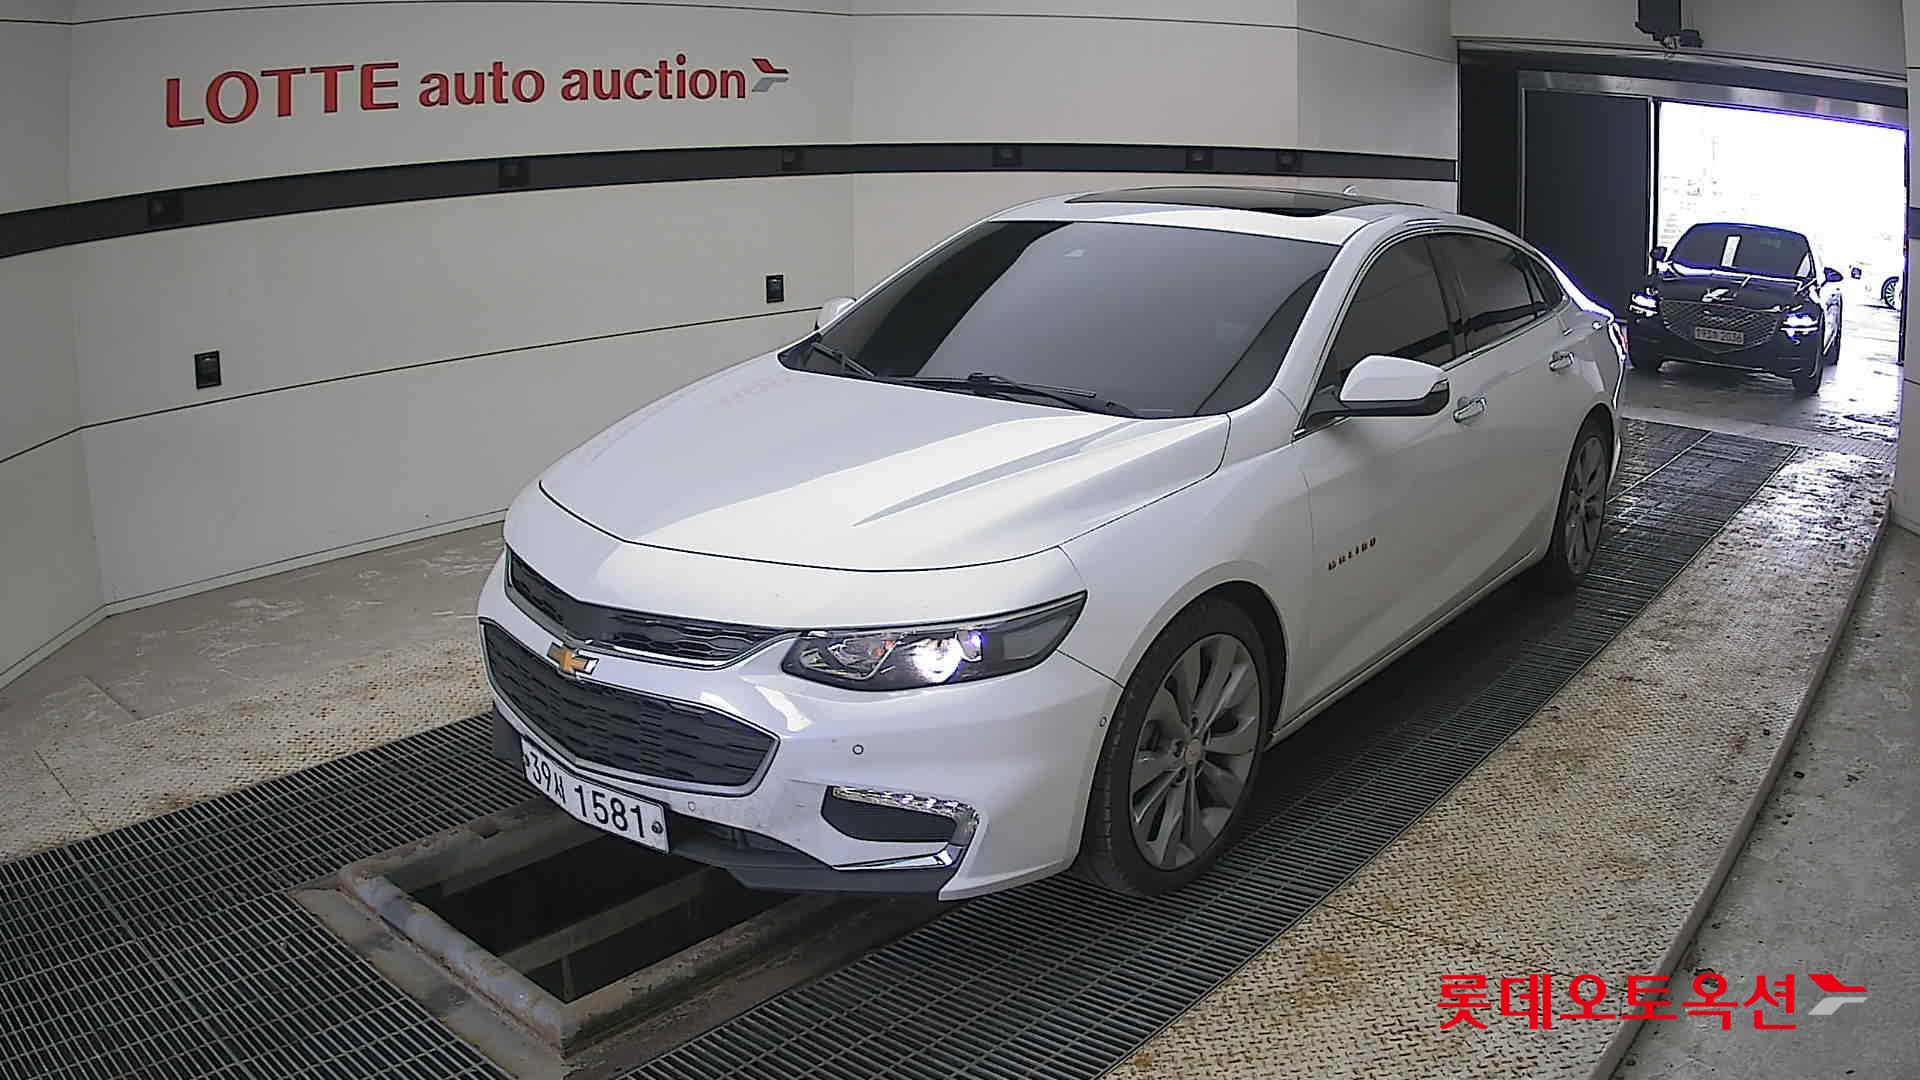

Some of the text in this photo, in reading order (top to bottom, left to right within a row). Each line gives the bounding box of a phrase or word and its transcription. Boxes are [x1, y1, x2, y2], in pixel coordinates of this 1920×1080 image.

[166, 54, 747, 128] LOTTE auto auction
[574, 784, 645, 838] 1581
